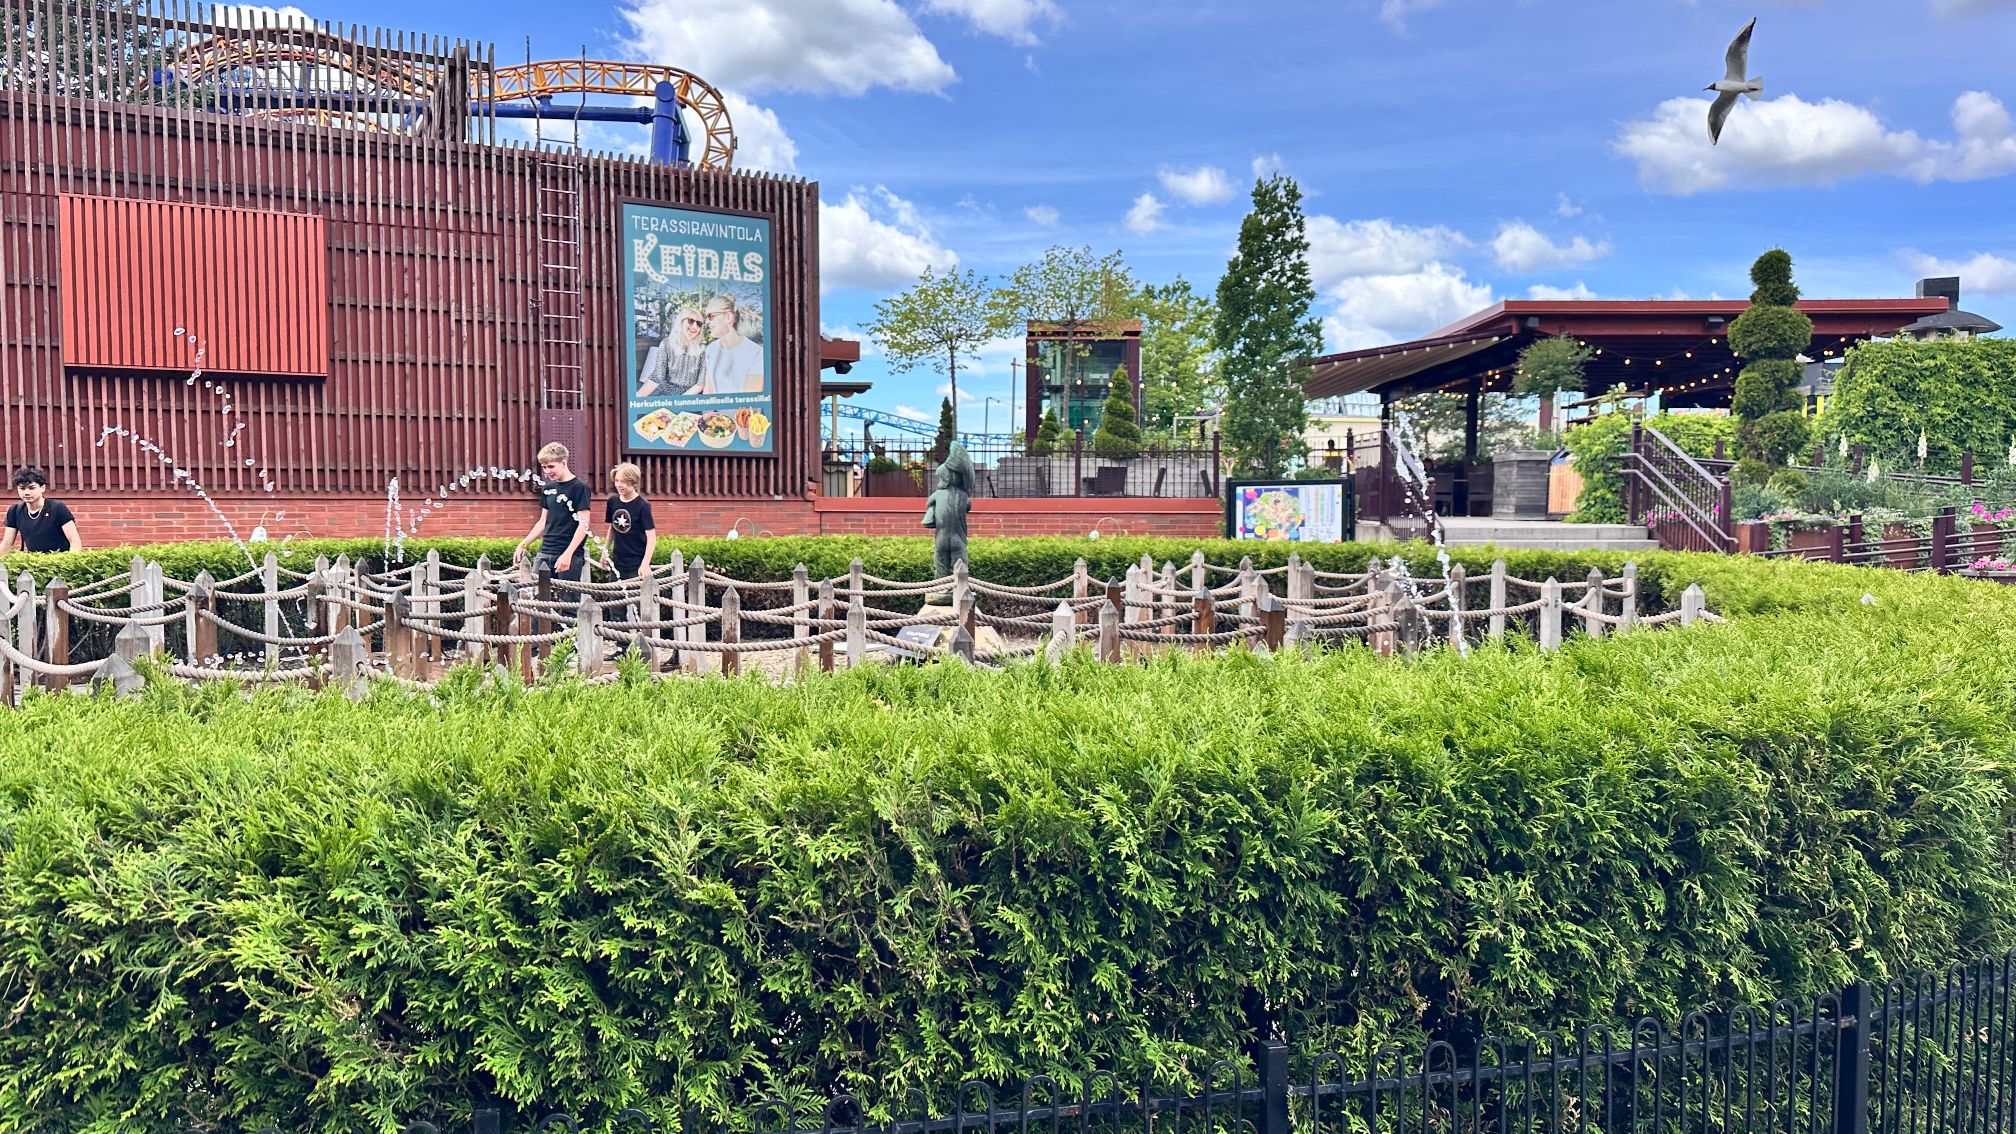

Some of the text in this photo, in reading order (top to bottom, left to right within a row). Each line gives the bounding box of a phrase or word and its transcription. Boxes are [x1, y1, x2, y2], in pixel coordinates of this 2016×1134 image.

[632, 215, 762, 242] TERASSIRAVINTOLA
[630, 395, 771, 408] Herkuttele tunnelmallisella terassilla!
